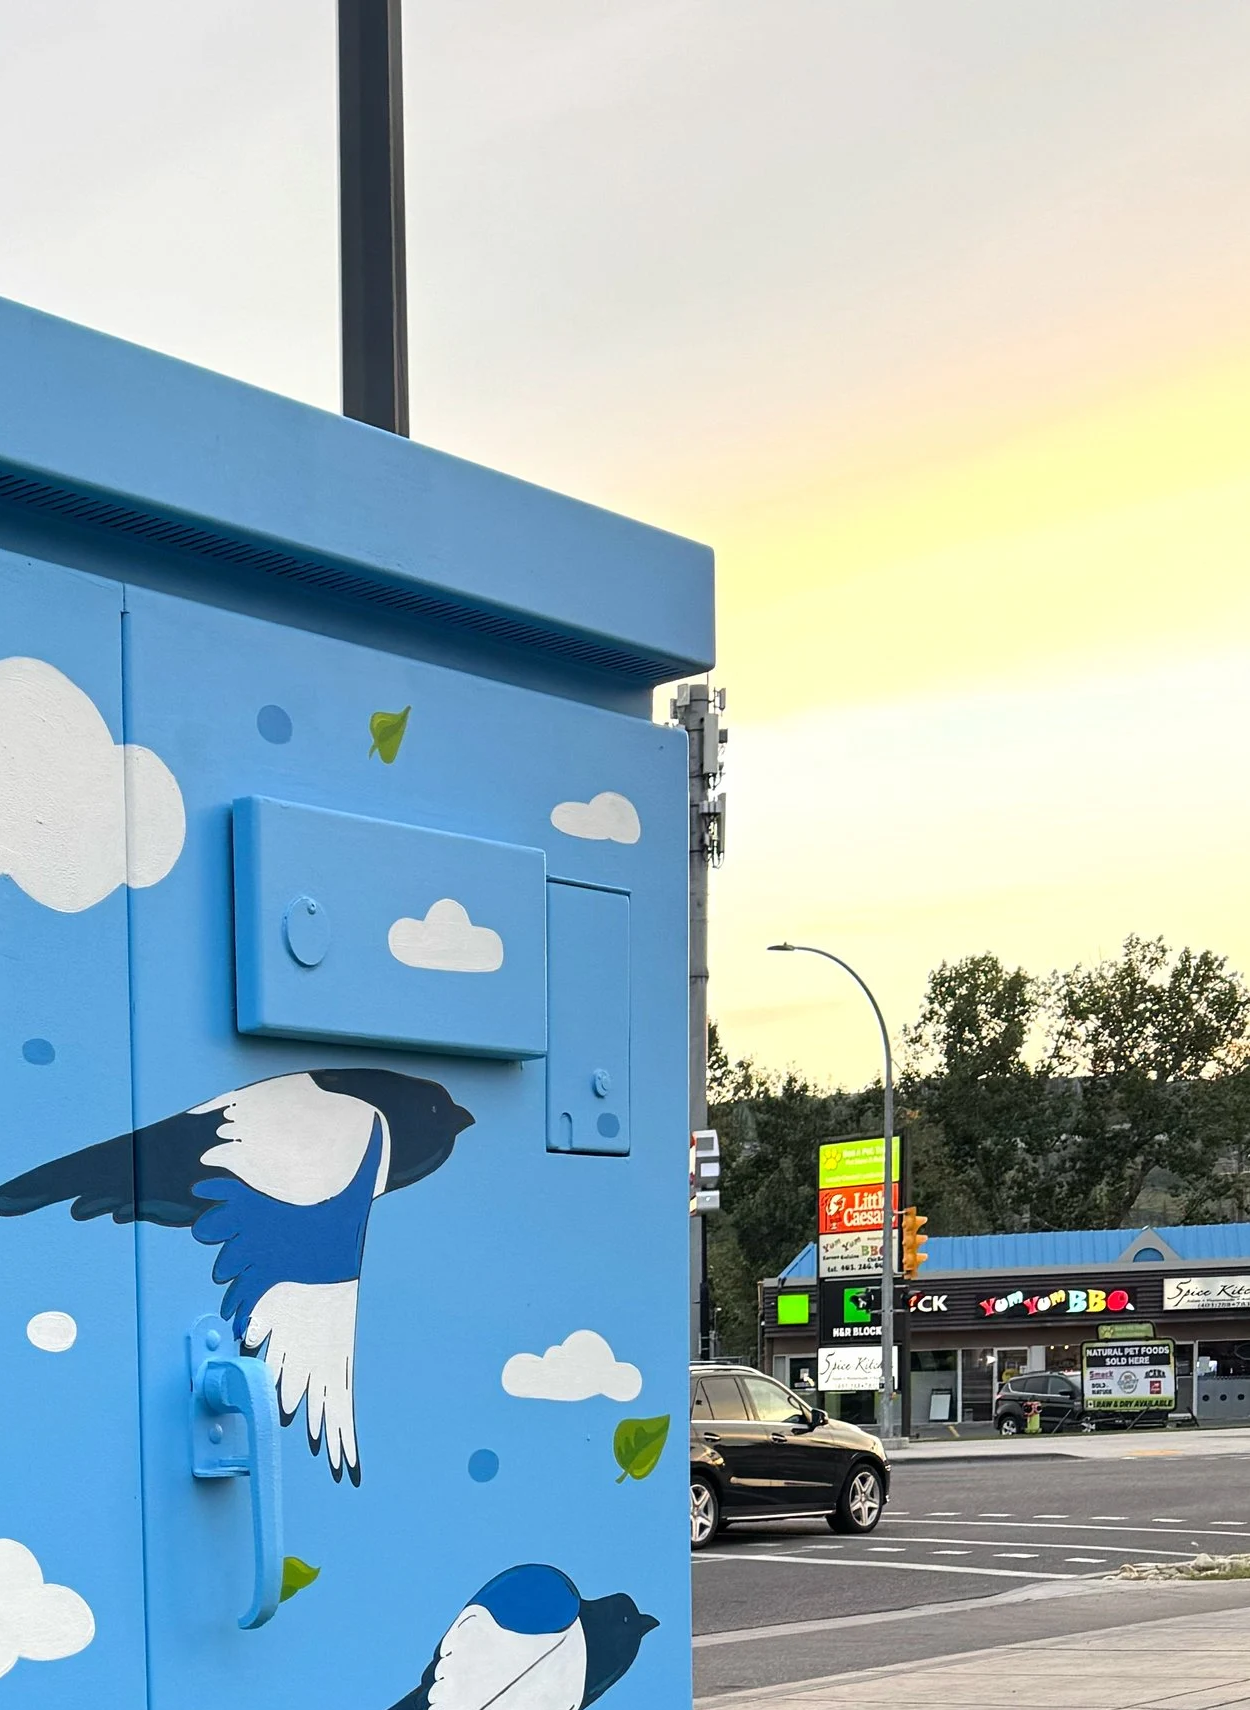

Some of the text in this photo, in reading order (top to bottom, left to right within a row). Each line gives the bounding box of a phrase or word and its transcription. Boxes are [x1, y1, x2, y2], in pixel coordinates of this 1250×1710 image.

[854, 1190, 884, 1211] Littl
[1066, 1289, 1135, 1313] BBQ
[1166, 1278, 1250, 1308] Spice Kitc
[832, 1326, 883, 1338] H&R BLOCK
[1086, 1346, 1169, 1357] NATURAL PET FOODS
[1105, 1357, 1150, 1366] SOLD HERE
[819, 1352, 851, 1384] Spice
